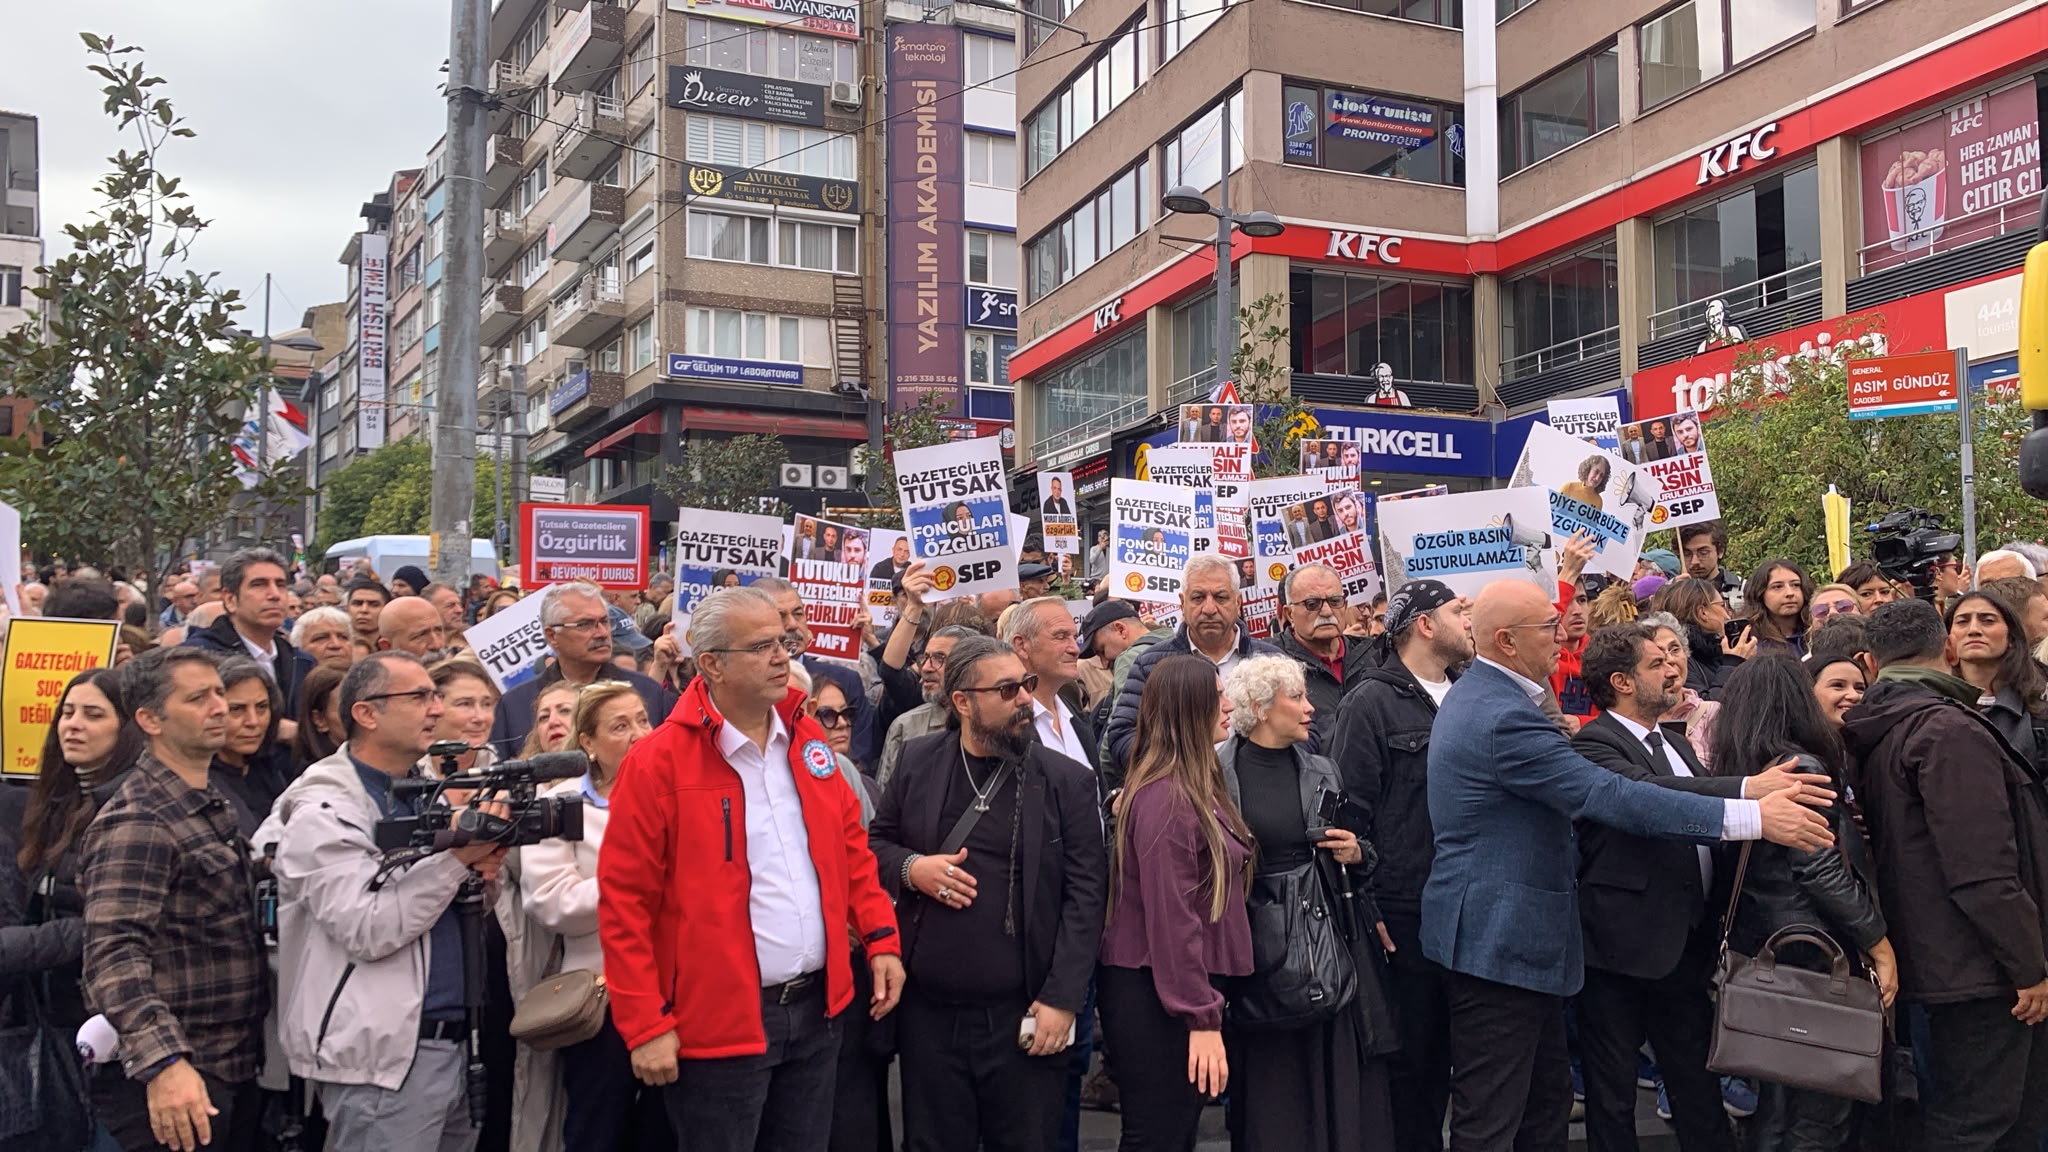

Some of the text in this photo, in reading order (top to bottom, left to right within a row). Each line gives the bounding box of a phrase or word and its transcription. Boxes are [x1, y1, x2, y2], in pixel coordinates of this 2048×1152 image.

[901, 43, 946, 53] smartpro
[905, 53, 946, 64] teknoloji
[678, 78, 754, 107] Queen
[1340, 117, 1423, 134] www.lionturizm.com
[1950, 114, 1983, 137] KFC
[1343, 127, 1421, 148] PRONTOTOUR
[1960, 142, 1985, 163] HER
[1987, 124, 2032, 153] ZAMAN
[1695, 122, 1777, 186] KFC
[745, 172, 800, 187] AVUKAT
[1961, 155, 1998, 186] HER
[1962, 177, 2013, 215] ÇITIR
[912, 81, 938, 354] YAZILIM AKADEMİSİ
[1325, 230, 1402, 264] KFC
[364, 258, 384, 298] TIME
[1092, 298, 1122, 333] KFC
[1978, 298, 2015, 321] 444
[363, 303, 383, 369] BRITISH
[692, 362, 799, 380] GELİŞİM TIP LABORATUVARI
[904, 375, 918, 383] 216
[947, 376, 958, 384] 66
[1852, 366, 1883, 376] GENERAL
[1853, 371, 1950, 394] ASIM GÜNDÜZ
[1853, 395, 1883, 405] CADDESİ
[1551, 411, 1618, 424] GAZETECİLER
[1554, 420, 1617, 435] TUTSAK
[899, 460, 1000, 486] GAZETECİLER
[1151, 464, 1213, 475] GAZETECİLER
[903, 472, 1003, 505] TUTSAK
[1215, 485, 1238, 498] EP
[1115, 497, 1192, 515] GAZETECİLER
[1670, 499, 1705, 518] SEP
[539, 520, 627, 531] Tutsak Gazetecilere
[912, 514, 1004, 540] FONCULAR
[1117, 507, 1191, 529] TUTSAK
[1577, 503, 1630, 540] GÜRBÜZ'E
[679, 531, 779, 550] GAZETECİLER
[1046, 524, 1076, 536] özgürlük!
[1415, 528, 1511, 550] ÖZGÜR BASIN
[538, 530, 627, 554] Özgürlük
[924, 531, 1000, 557] ÖZGÜR!
[1118, 538, 1187, 555] FONCULAR
[1223, 541, 1243, 554] MFT
[1296, 533, 1364, 565] MUHALİF
[681, 543, 777, 568] TUTSAK
[1124, 549, 1183, 570] ÖZGÜR!
[1408, 548, 1523, 572] SUSTURULAMAZ!
[550, 564, 635, 582] DEVRİMCİ DURUŞ
[795, 558, 860, 584] TUTUKLU
[958, 560, 1002, 584] SEP
[1147, 576, 1180, 593] SEP
[478, 614, 541, 661] GAZETEC
[815, 633, 850, 652] MFT
[15, 651, 99, 673] GAZETECİLİK
[36, 680, 63, 704] SUÇ
